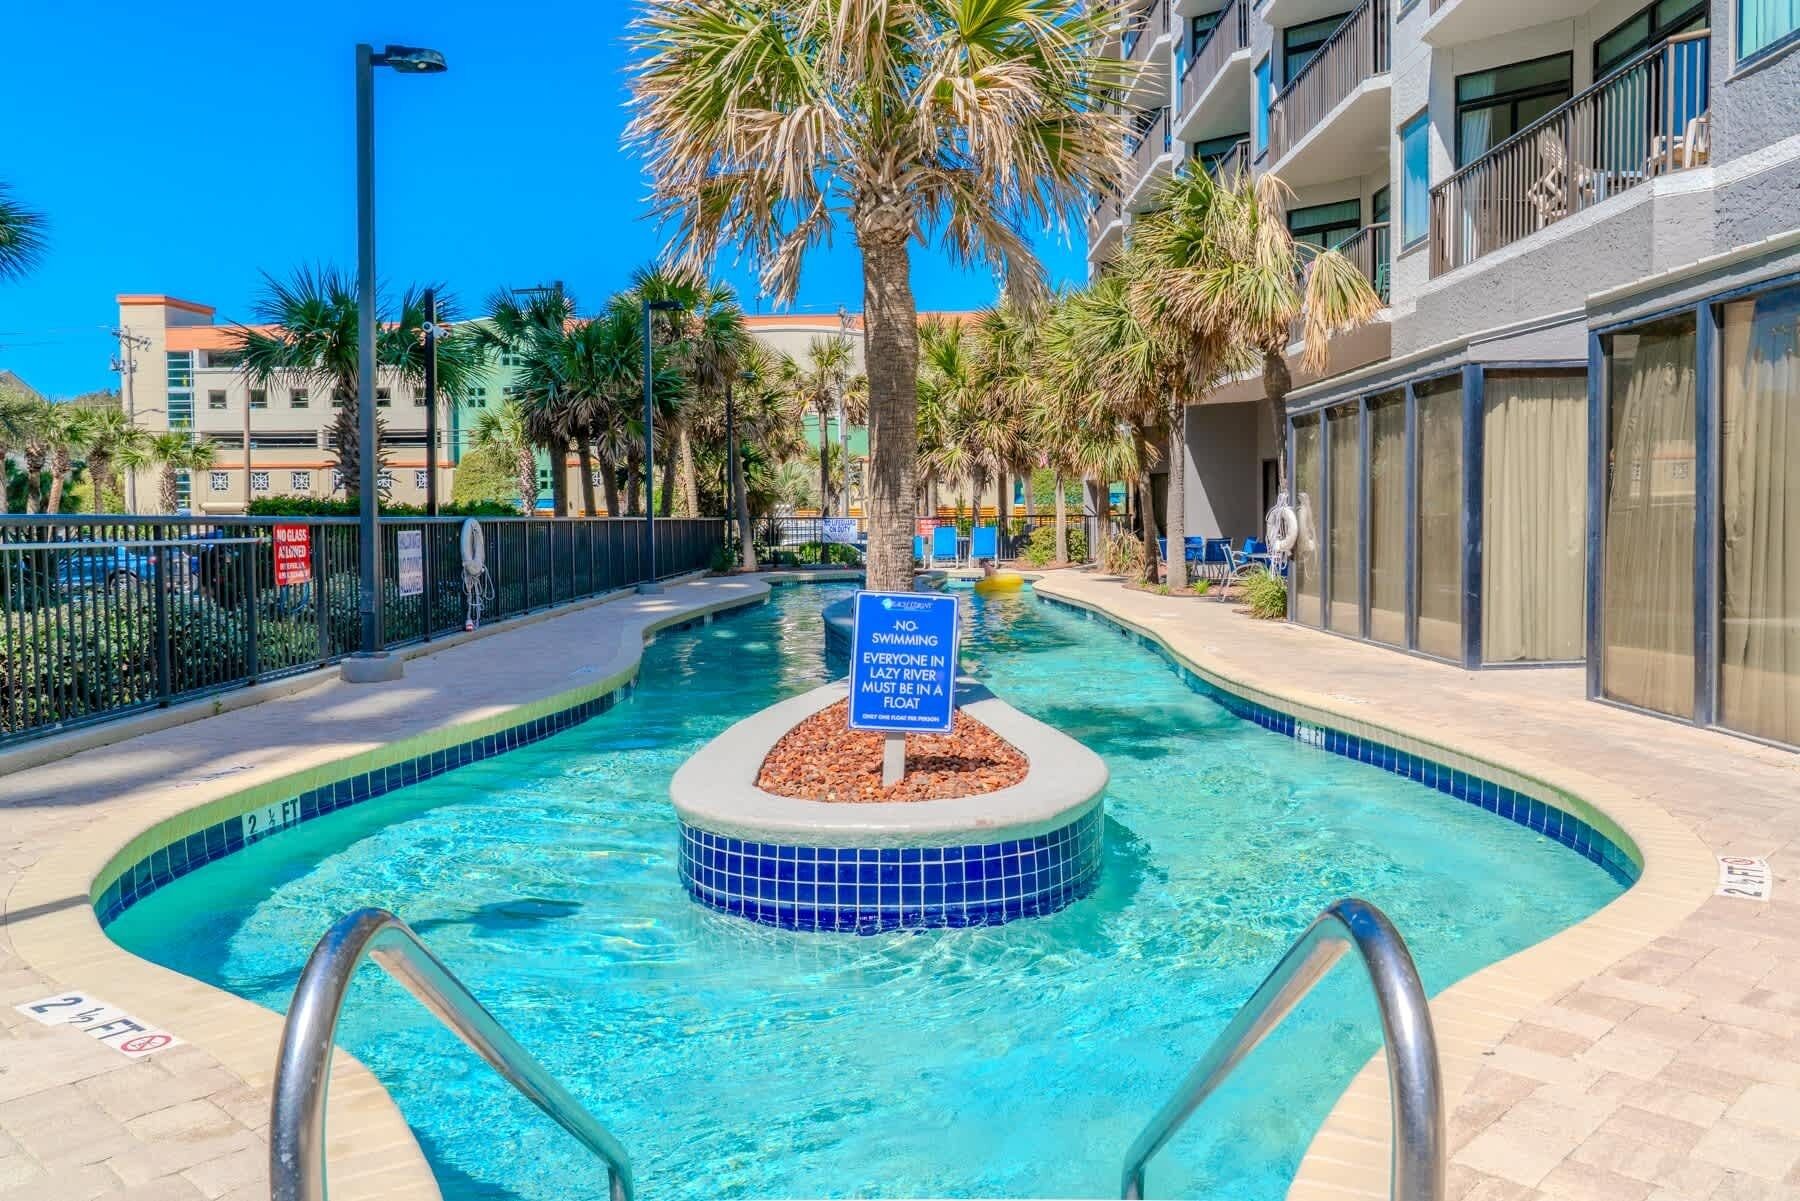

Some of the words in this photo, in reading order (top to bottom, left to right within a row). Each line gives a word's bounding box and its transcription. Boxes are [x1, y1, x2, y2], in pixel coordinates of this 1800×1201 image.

[276, 529, 287, 542] NO
[287, 529, 307, 542] GLASS
[872, 633, 938, 646] SWIMMING
[863, 652, 928, 667] EVERYONE
[930, 655, 945, 667] IN
[870, 667, 901, 679] LAZY
[903, 668, 936, 681] RIVER
[862, 681, 896, 694] MUST
[899, 682, 914, 694] BE
[916, 684, 931, 695] IN
[932, 684, 943, 696] A
[884, 696, 920, 709] FLOAT
[248, 814, 257, 834] 2
[281, 797, 298, 824] FT
[1727, 866, 1765, 878] FT
[29, 997, 84, 1014] 2
[83, 1016, 147, 1040] FT
